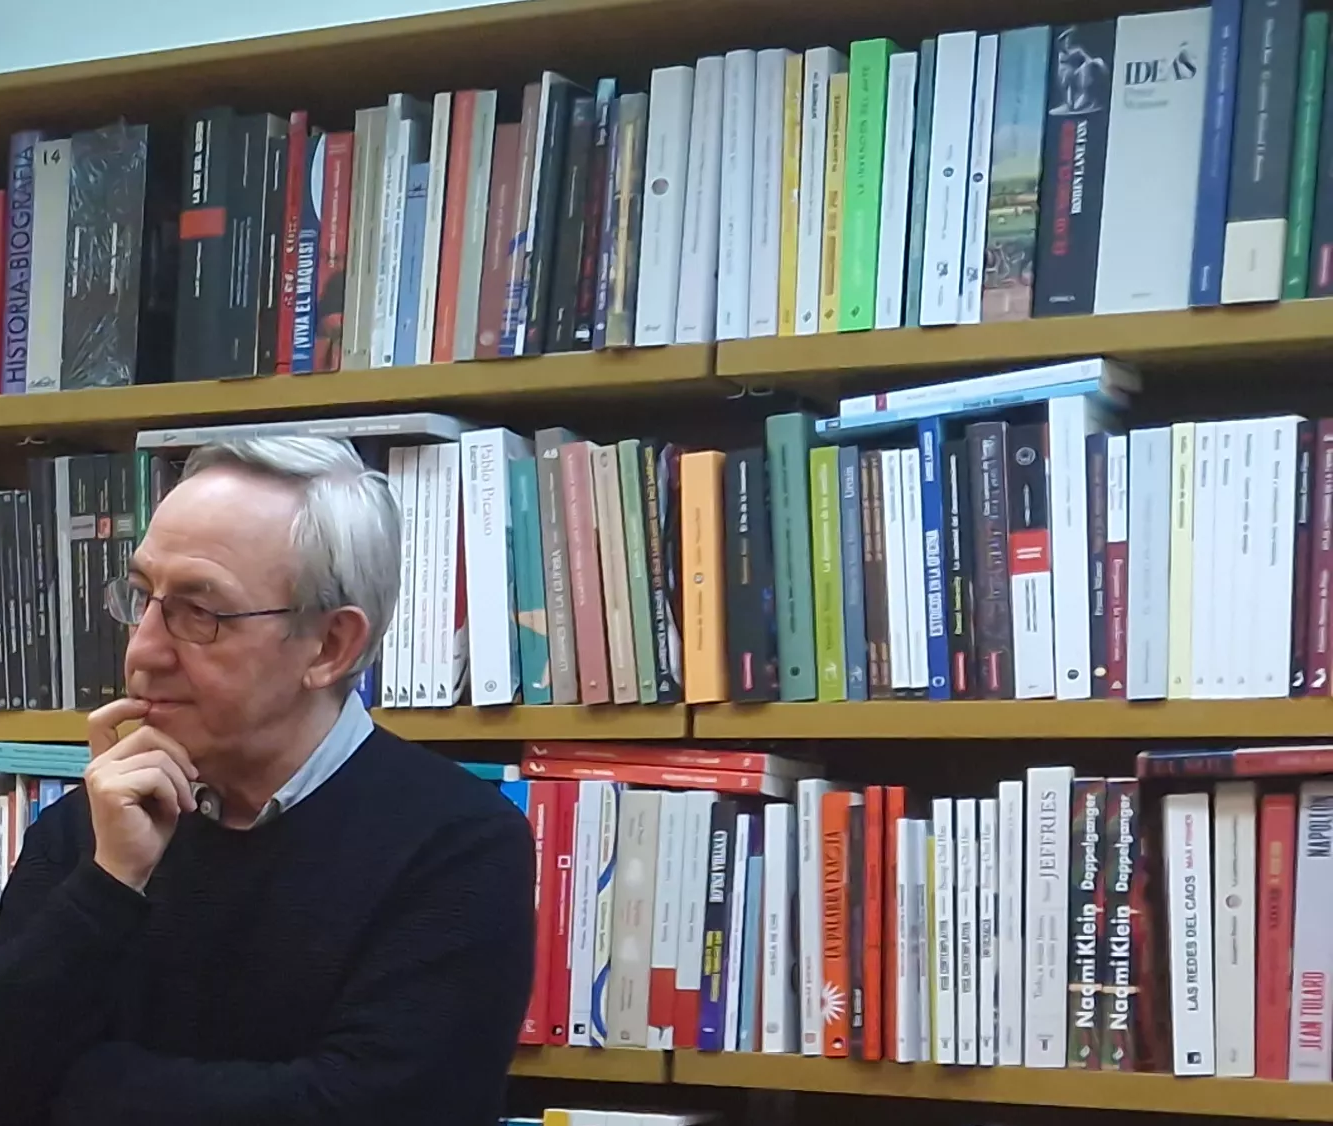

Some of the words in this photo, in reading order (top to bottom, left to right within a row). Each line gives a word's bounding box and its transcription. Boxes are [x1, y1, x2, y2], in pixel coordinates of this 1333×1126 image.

[295, 242, 314, 294] MAQUIS!
[295, 296, 311, 313] EL
[293, 315, 312, 348] ¡VIVA
[480, 444, 495, 482] Pablo
[481, 487, 494, 537] Picasso
[1038, 790, 1059, 880] JEFFRIES
[1080, 793, 1099, 891] Doppelganger
[1114, 793, 1133, 893] Doppelganger
[1183, 874, 1197, 911] CAOS
[1076, 903, 1097, 957] Klein
[1110, 905, 1131, 958] Klein
[1184, 913, 1198, 937] DEL
[823, 943, 841, 961] LA
[1184, 940, 1198, 984] REDES
[1076, 959, 1097, 1029] Naomi
[1109, 959, 1131, 1031] Naomi
[1185, 985, 1199, 1012] LAS
[1300, 971, 1326, 1017] TULARD
[1298, 1020, 1324, 1052] JEAN
